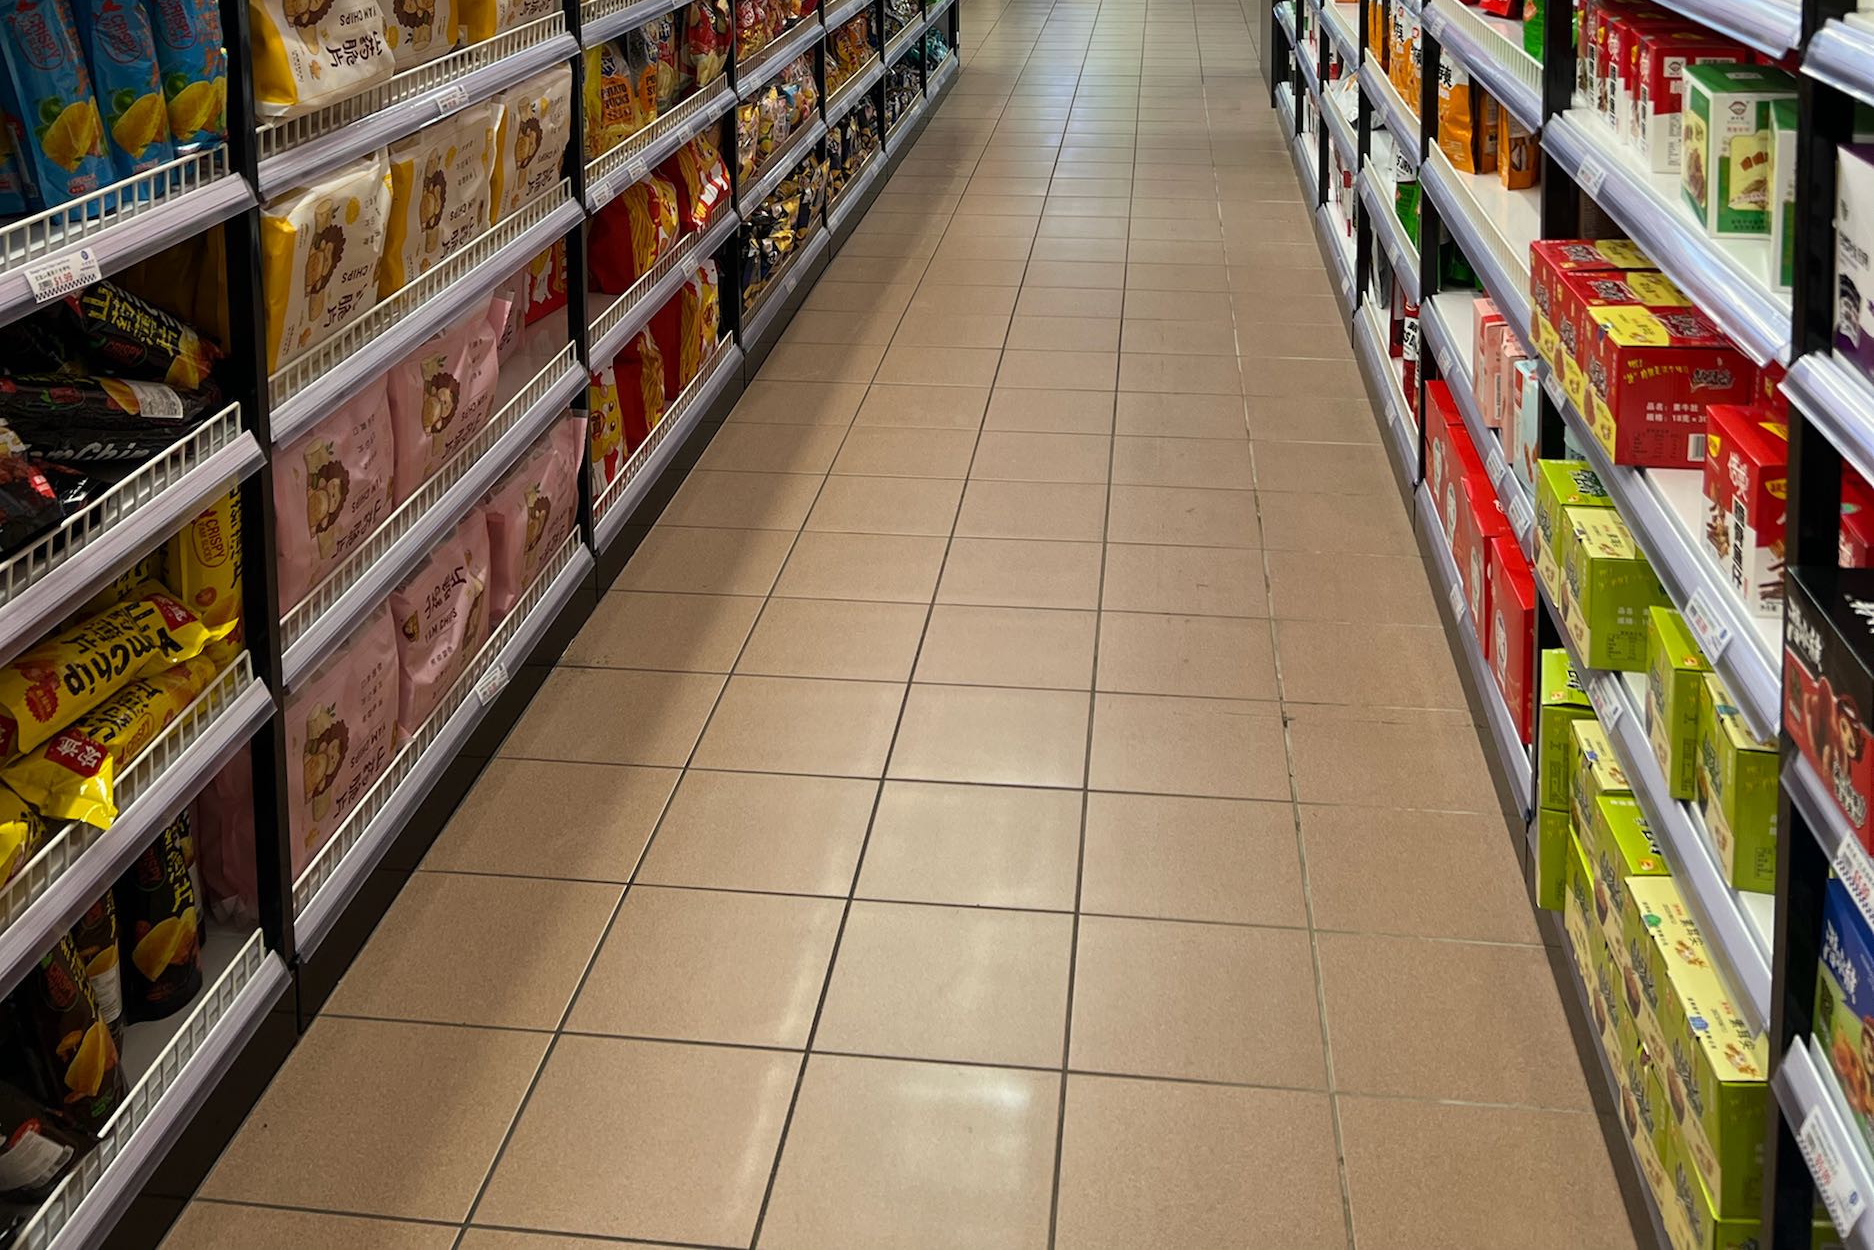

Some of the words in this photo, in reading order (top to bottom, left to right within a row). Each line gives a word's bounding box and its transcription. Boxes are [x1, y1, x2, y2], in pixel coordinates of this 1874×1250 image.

[339, 7, 363, 26] CHIPS
[32, 13, 61, 61] CRISPY
[601, 83, 627, 100] POTATO
[53, 272, 74, 286] $1.99
[341, 264, 369, 284] CHIPS
[206, 517, 226, 560] CRISPY
